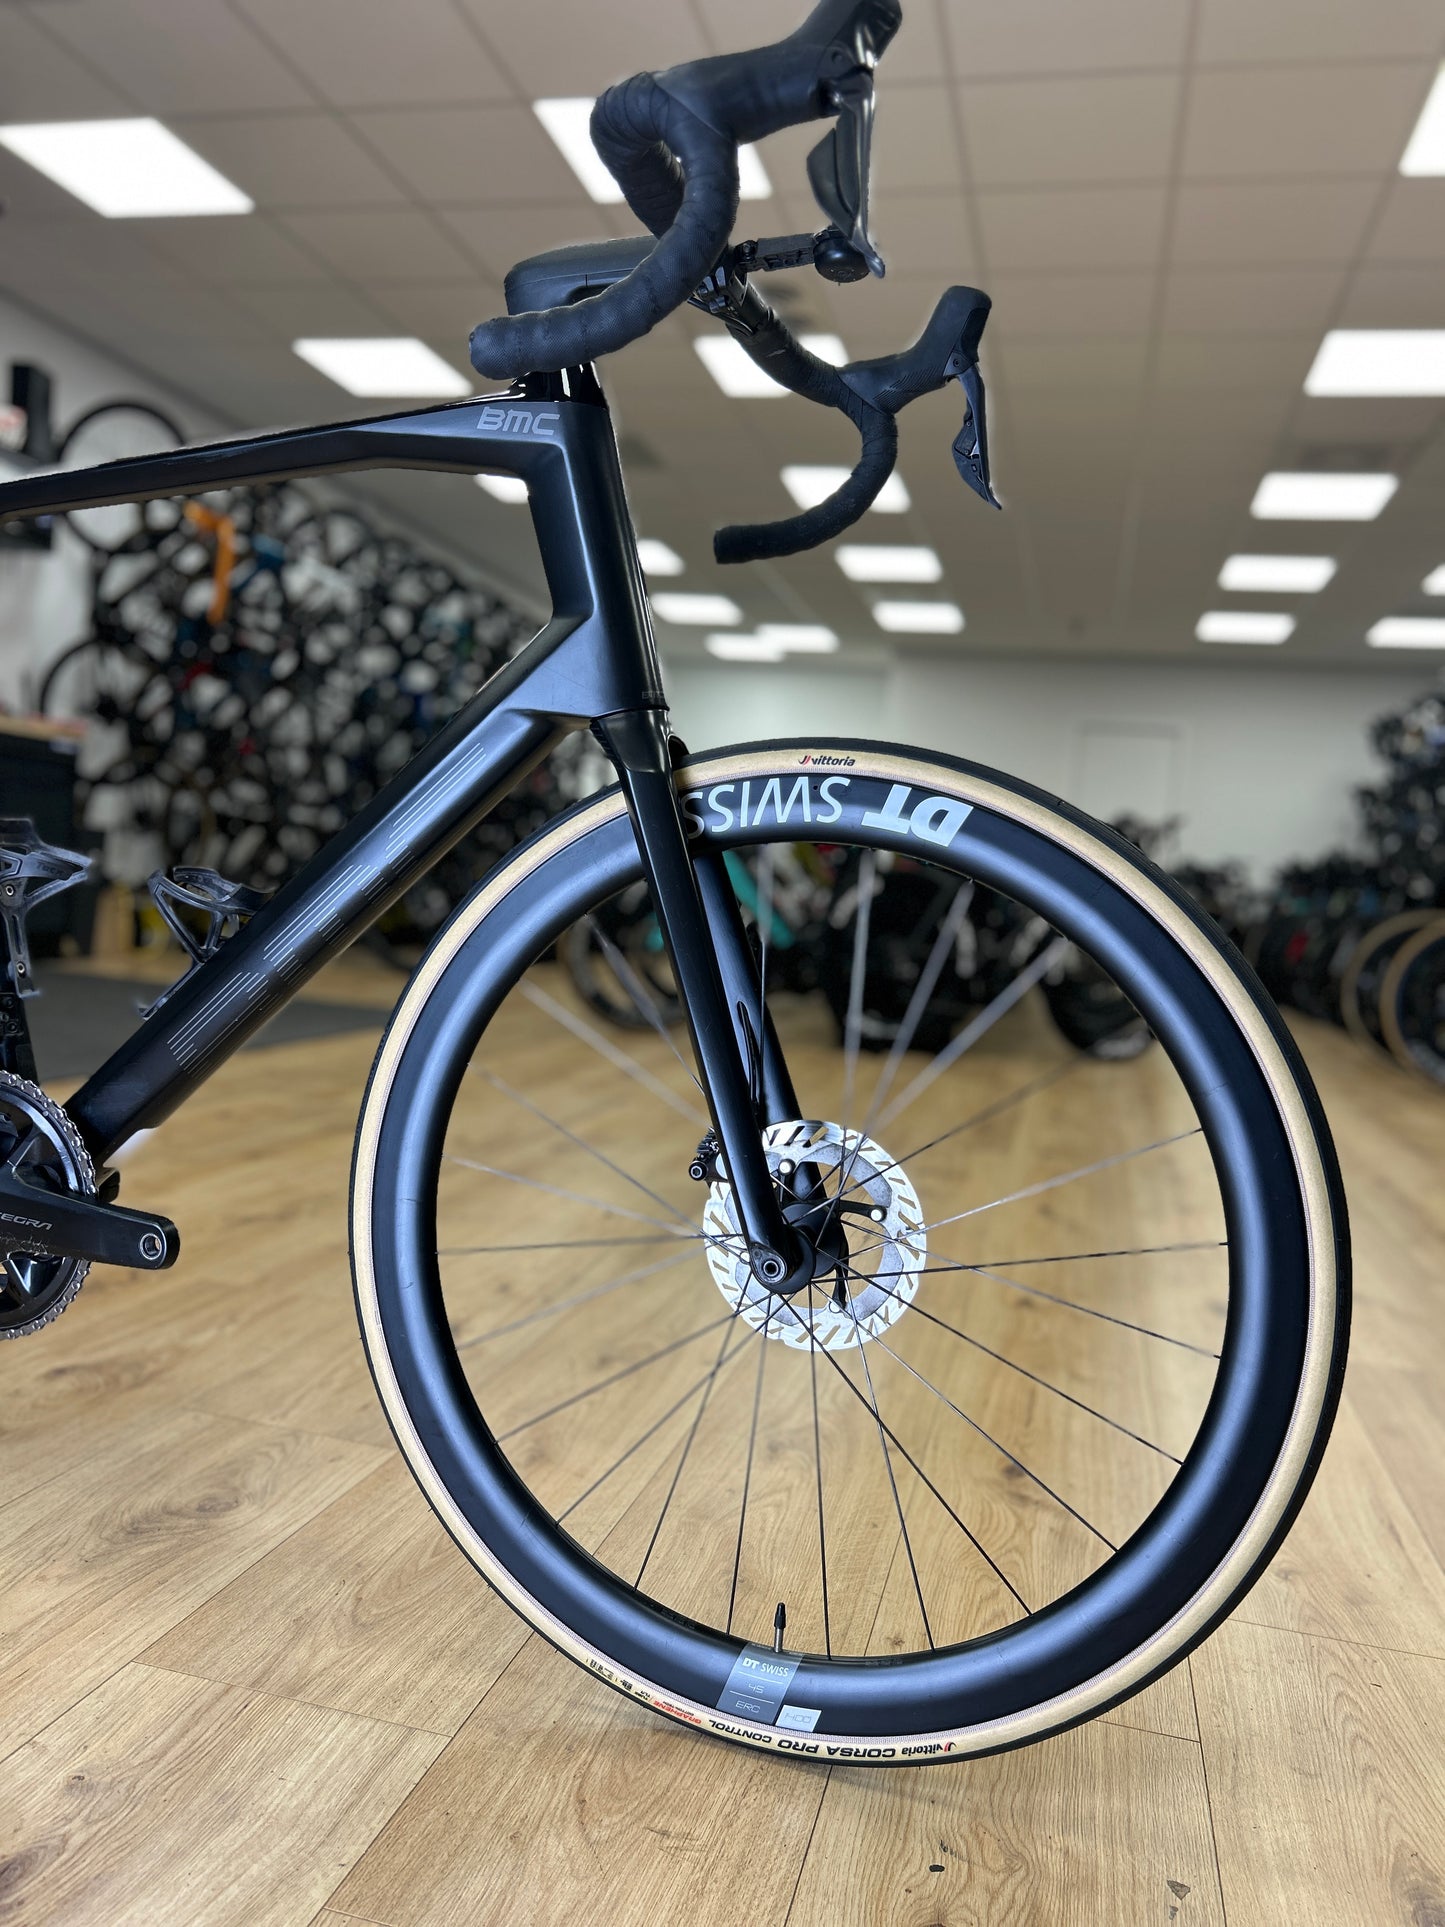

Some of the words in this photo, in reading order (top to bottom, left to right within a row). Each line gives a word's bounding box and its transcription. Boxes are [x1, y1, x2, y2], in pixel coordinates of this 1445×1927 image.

[477, 406, 560, 436] BMC
[811, 755, 856, 767] vittoria
[682, 776, 851, 839] SWISS
[861, 783, 974, 848] DT
[0, 1212, 53, 1231] EGRA
[742, 1657, 760, 1670] DT
[760, 1662, 789, 1677] SWISS
[748, 1682, 766, 1694] 45
[652, 1700, 702, 1725] GRAPHENE
[735, 1700, 761, 1713] ERC
[708, 1718, 772, 1744] CONTROL
[777, 1738, 820, 1754] PRO
[826, 1745, 896, 1758] CORSA
[901, 1742, 944, 1756] vittoria
